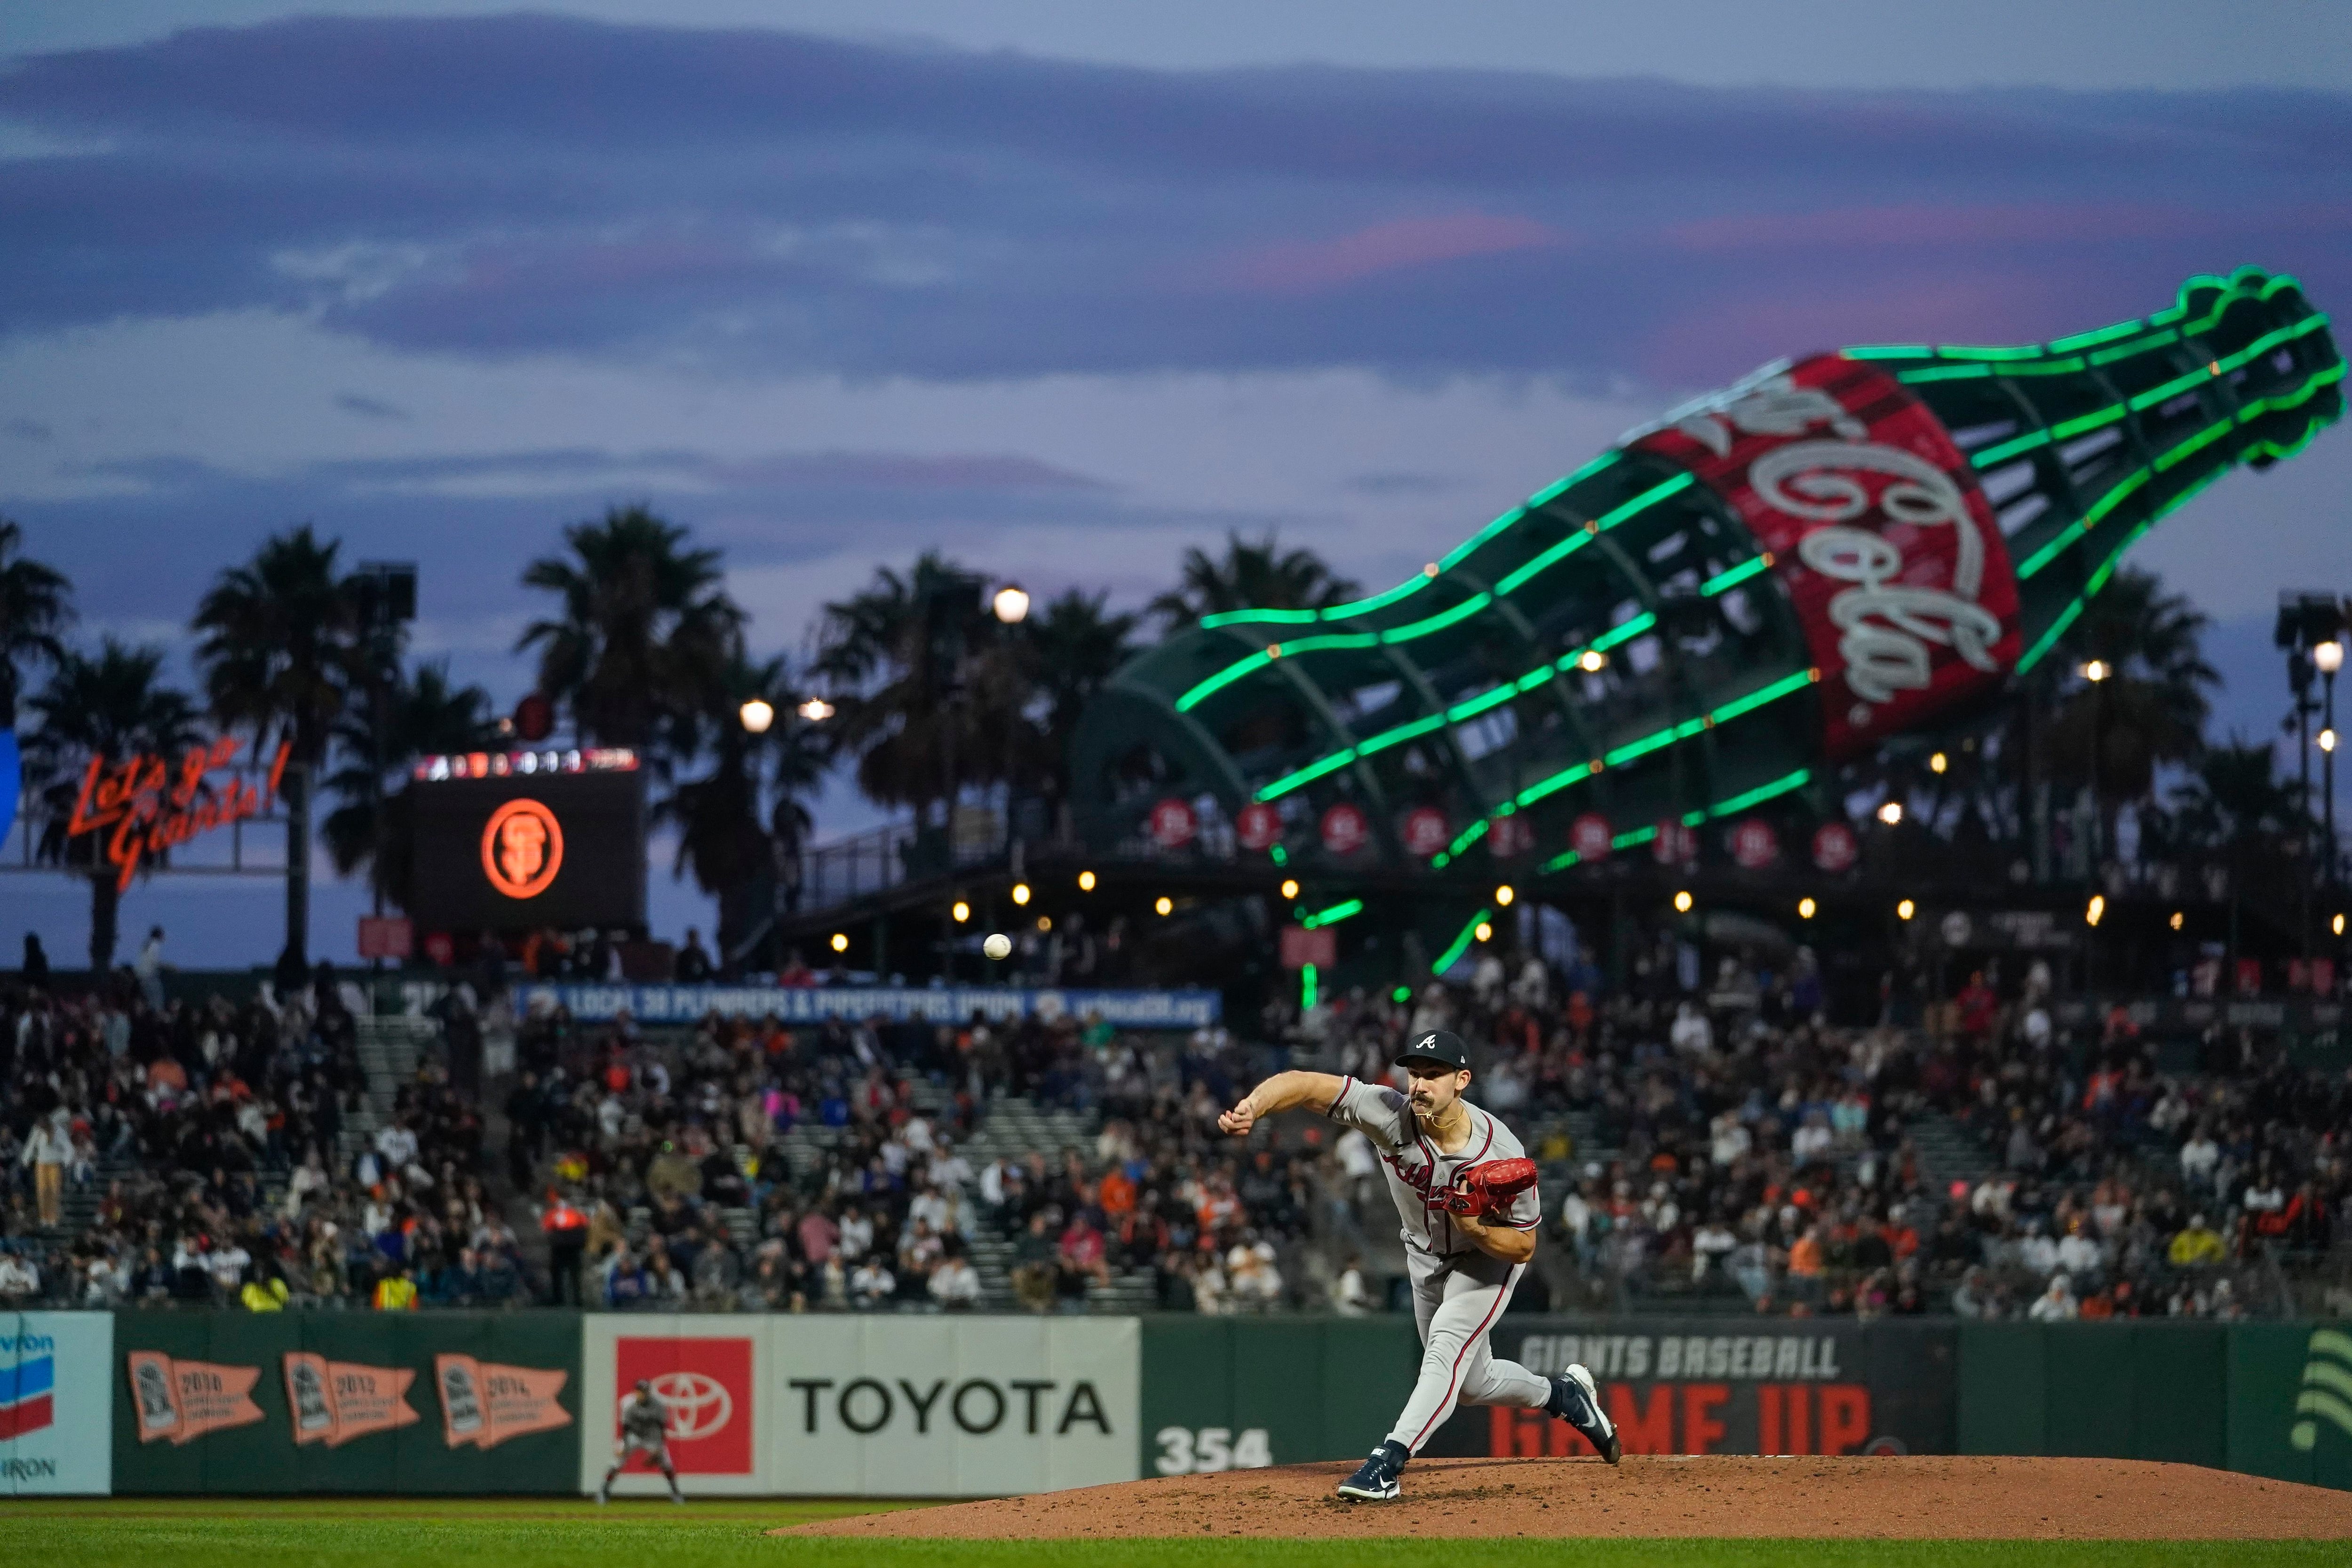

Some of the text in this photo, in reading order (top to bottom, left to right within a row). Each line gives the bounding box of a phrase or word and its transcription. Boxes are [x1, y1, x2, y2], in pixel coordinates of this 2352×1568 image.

[1416, 1035, 1436, 1049] A
[1519, 1335, 1840, 1379] GIANTS BASEBALL
[788, 1377, 1112, 1435] TOYOTA
[1757, 1384, 1871, 1456] UP
[1156, 1426, 1271, 1475] 354
